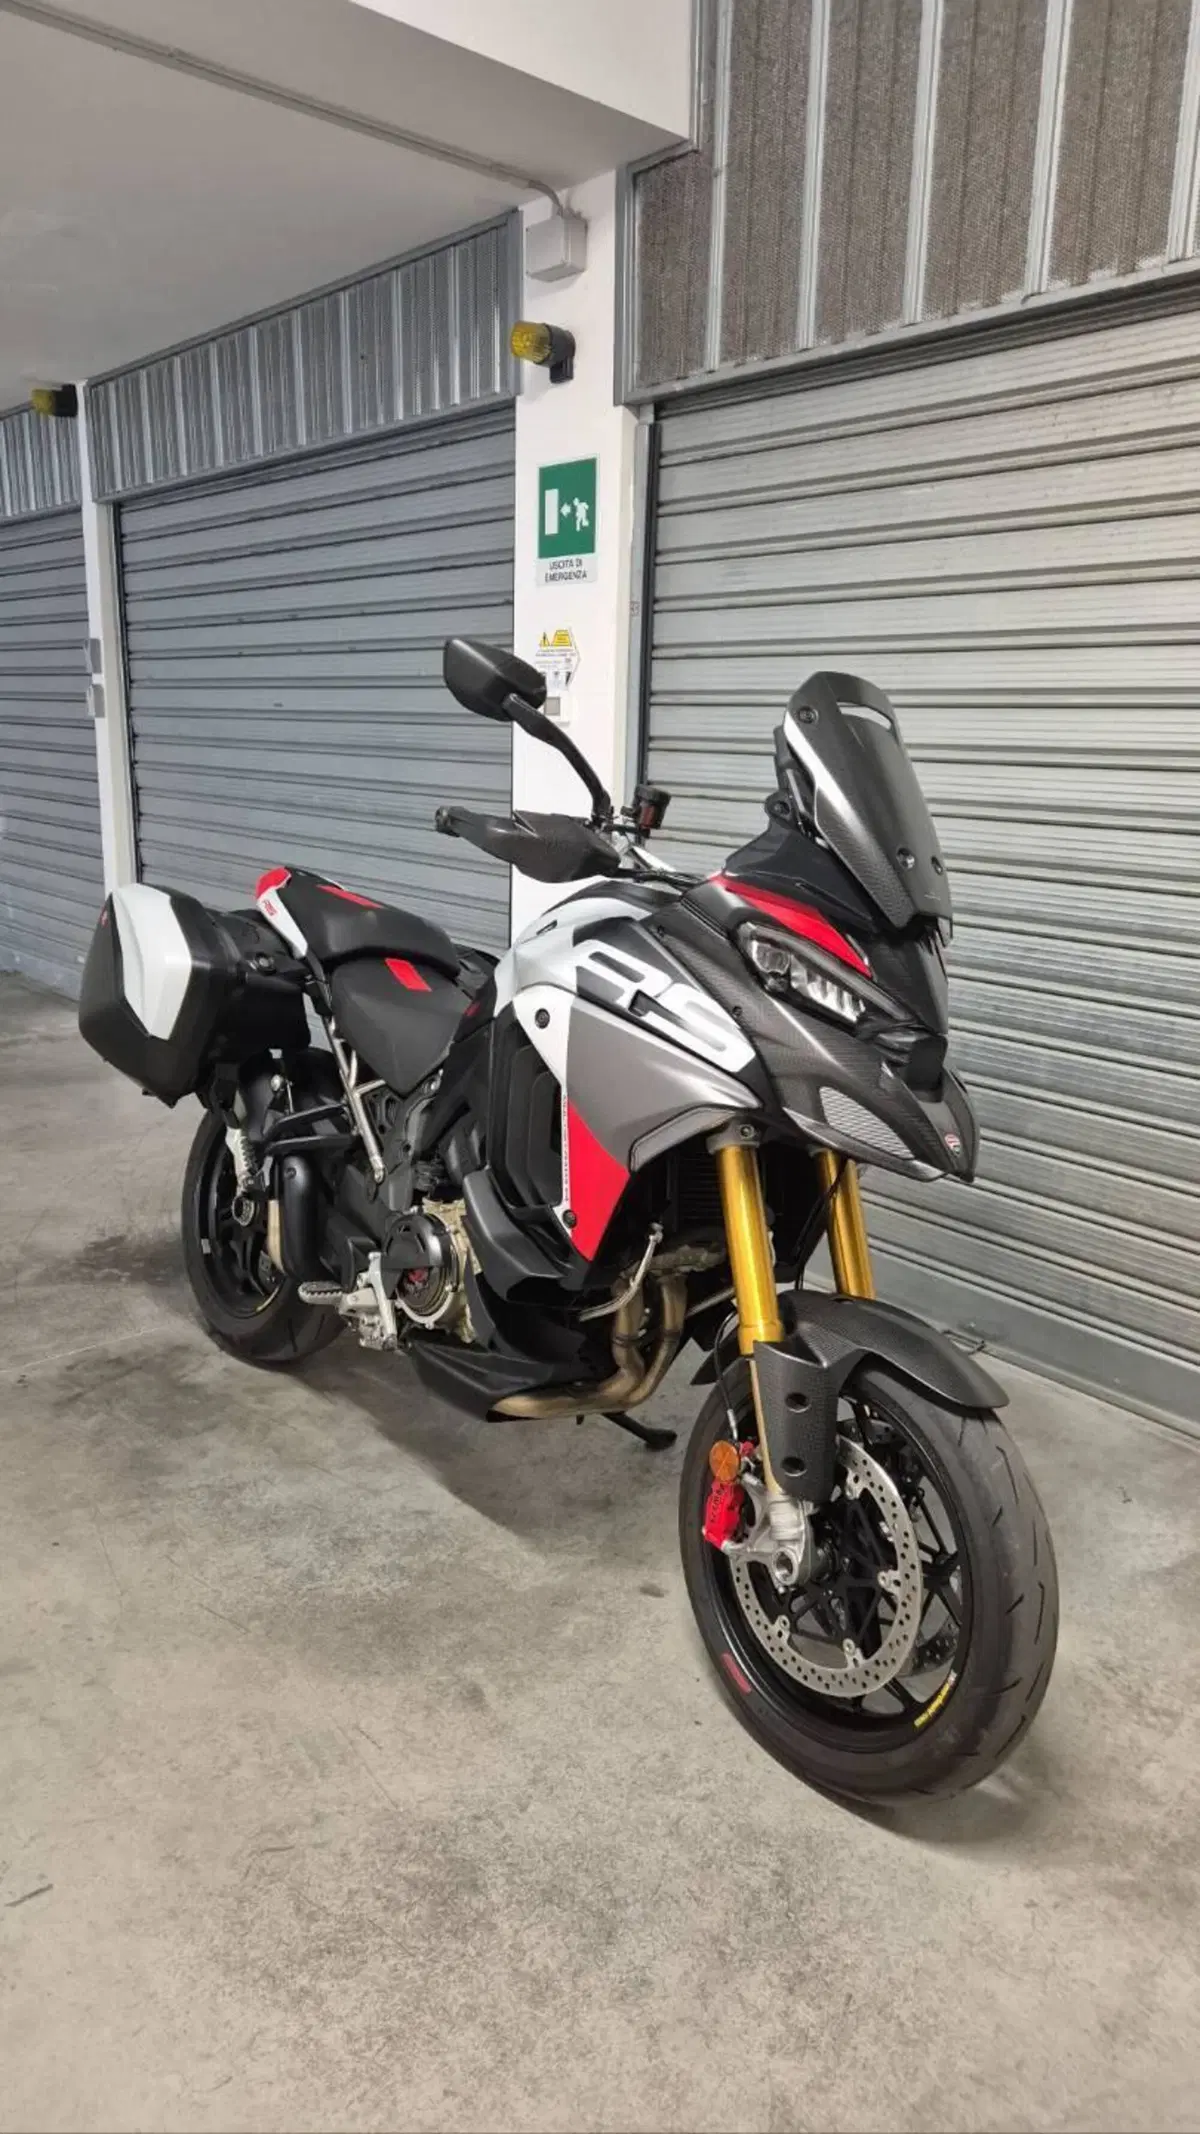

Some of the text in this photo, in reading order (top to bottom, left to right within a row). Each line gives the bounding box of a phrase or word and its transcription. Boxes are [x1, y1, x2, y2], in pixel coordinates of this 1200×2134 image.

[549, 558, 583, 570] USCITA DI
[544, 569, 588, 583] EMERGENZA
